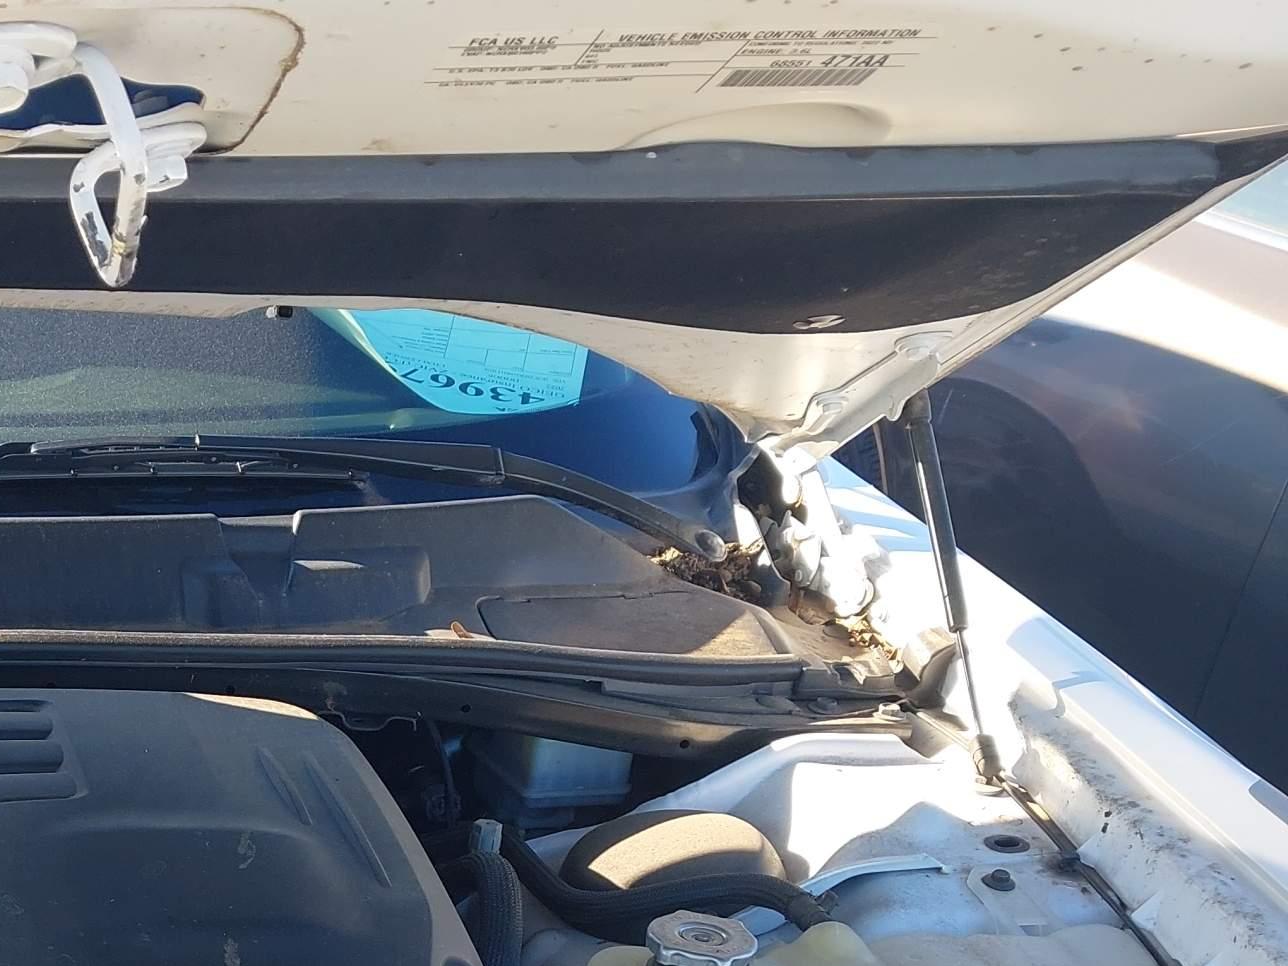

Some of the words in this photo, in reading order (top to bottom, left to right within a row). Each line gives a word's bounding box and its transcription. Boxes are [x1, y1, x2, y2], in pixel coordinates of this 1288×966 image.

[469, 37, 498, 46] FCA
[504, 36, 526, 45] US
[530, 35, 559, 45] LLC
[618, 32, 678, 42] VEHICLE
[681, 31, 751, 41] EMISSION
[754, 30, 818, 39] CONTROL
[823, 28, 922, 38] INFORMATION
[820, 55, 891, 67] 471AA
[384, 361, 545, 405] 43967
